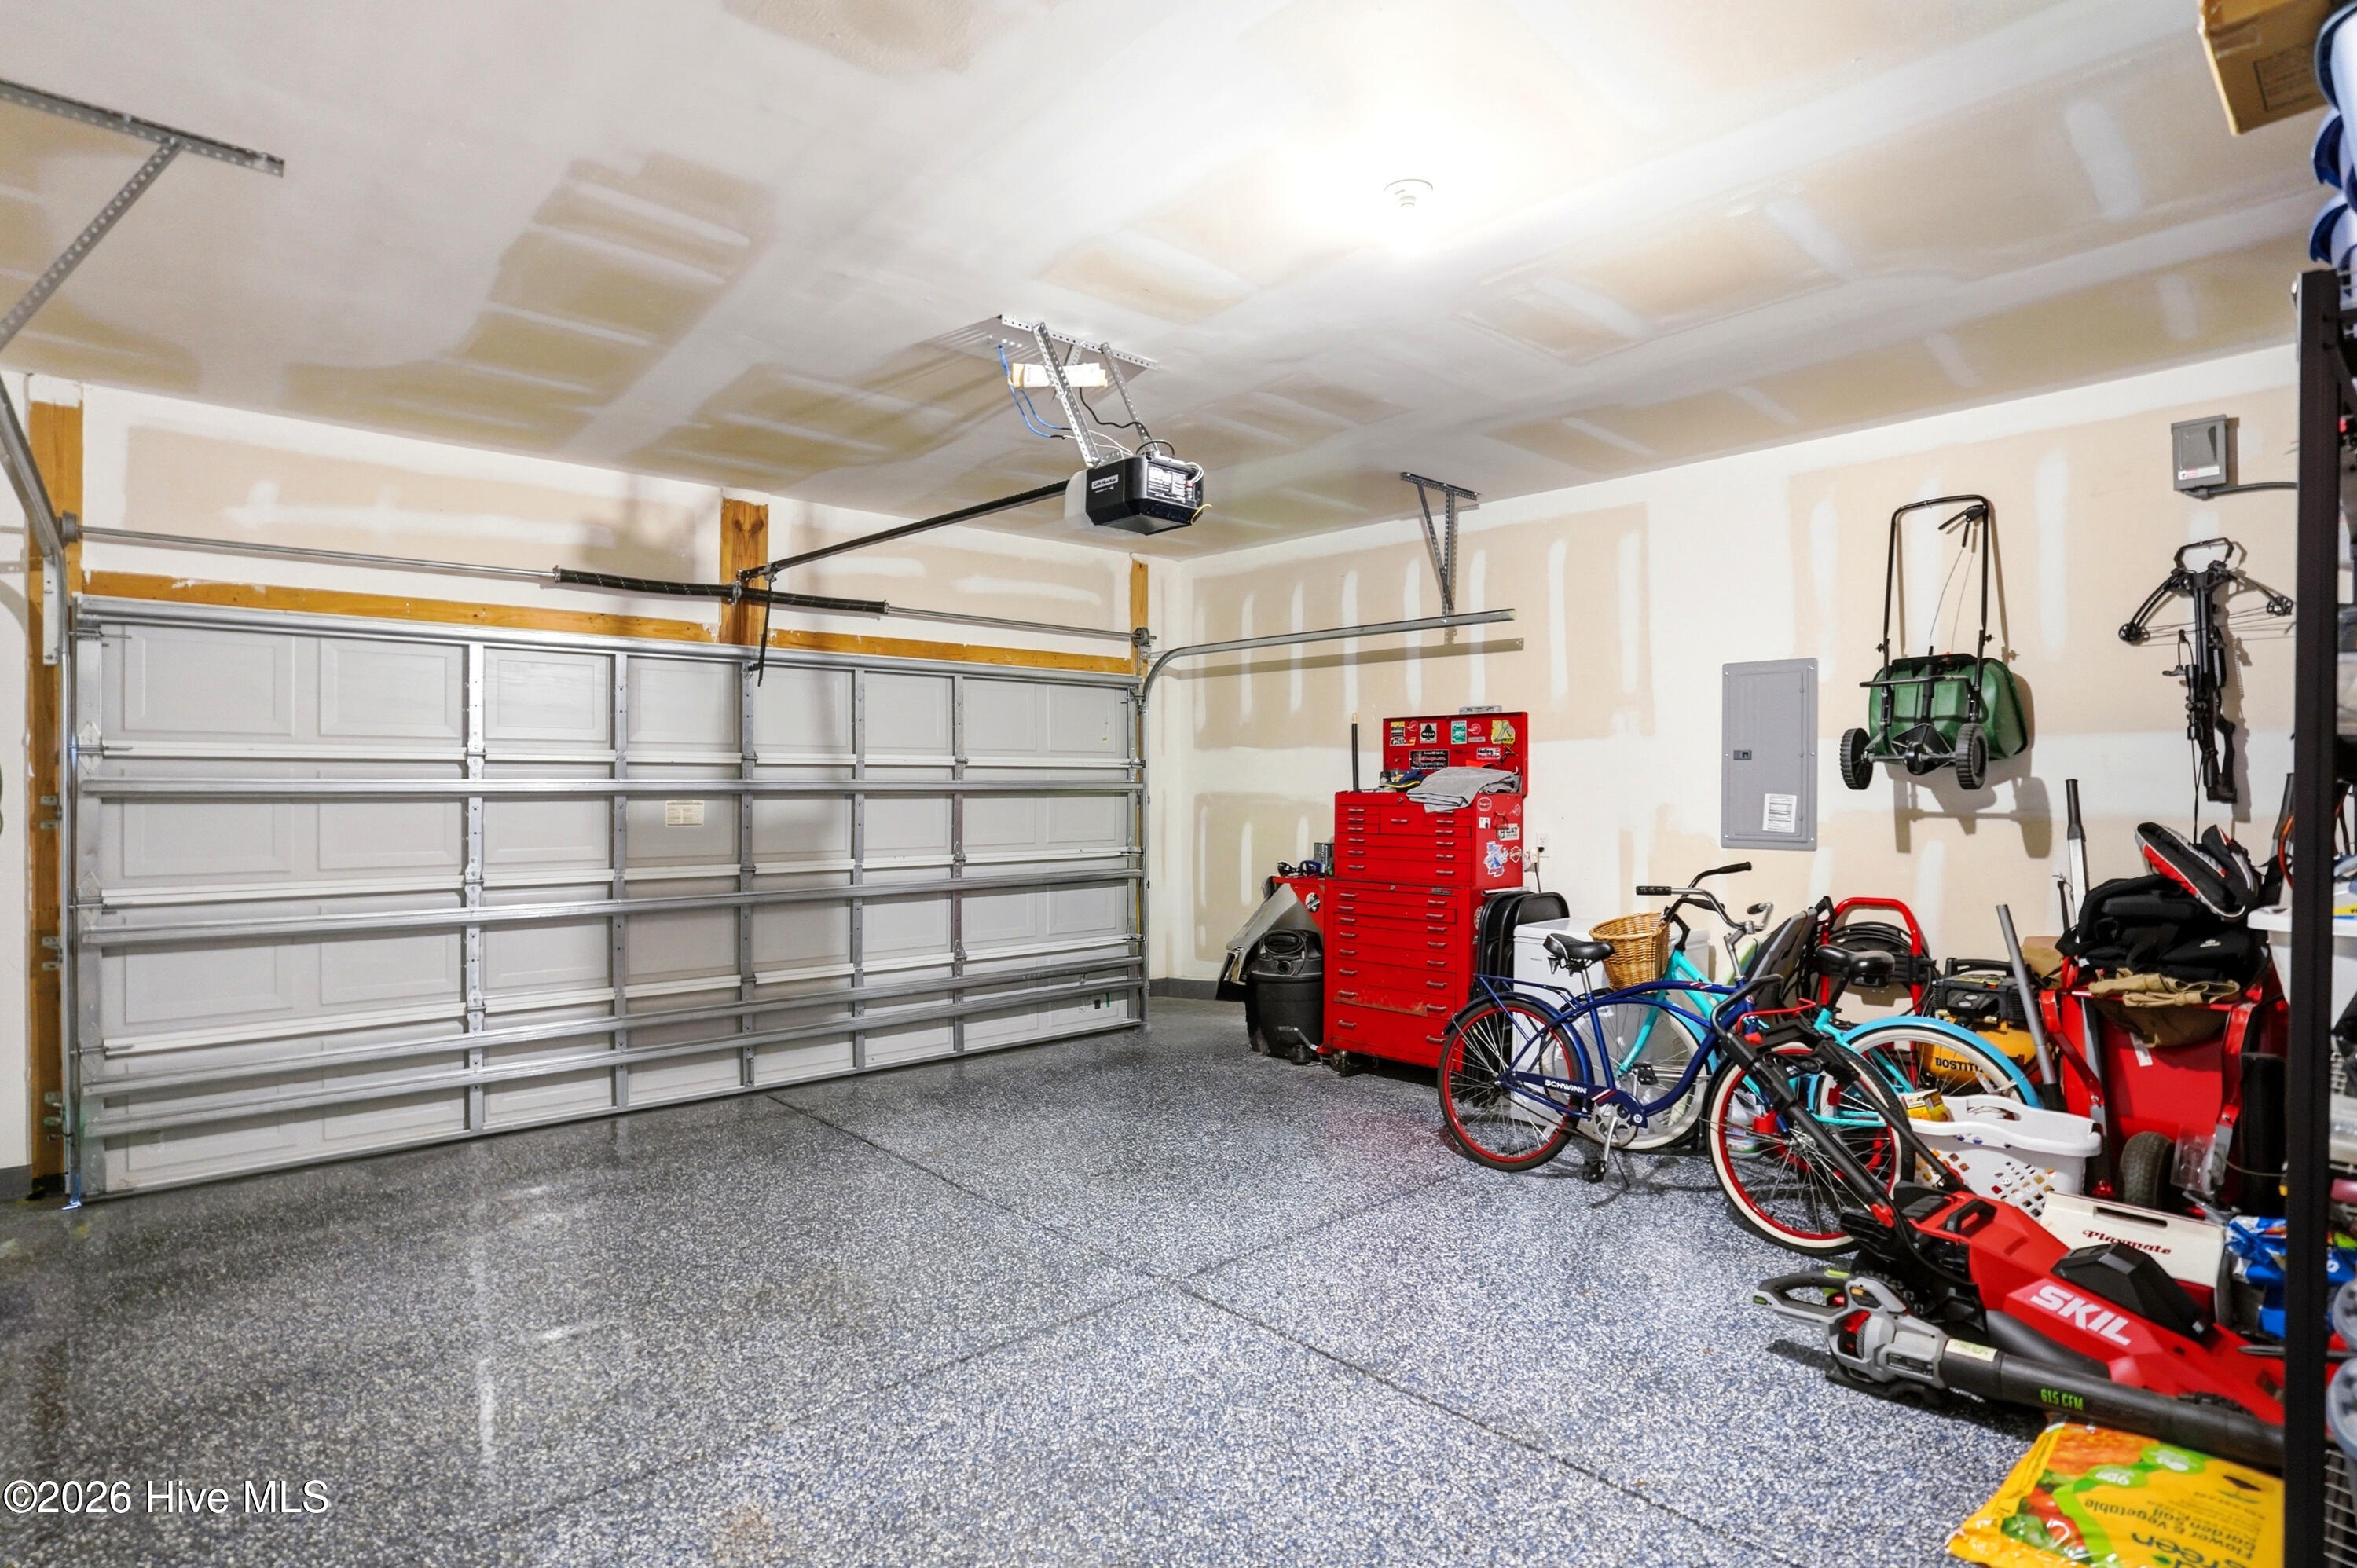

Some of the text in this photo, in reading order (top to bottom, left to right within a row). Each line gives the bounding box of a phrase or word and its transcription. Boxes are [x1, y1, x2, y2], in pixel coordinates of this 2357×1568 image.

[1935, 1057, 1984, 1073] BOSTIT
[1545, 1079, 1587, 1094] SCHWINN
[2029, 1284, 2132, 1346] SKIL
[2040, 1388, 2084, 1411] 615 CFM
[2084, 1499, 2168, 1530] Vegetable
[2190, 1531, 2253, 1559] Flower
